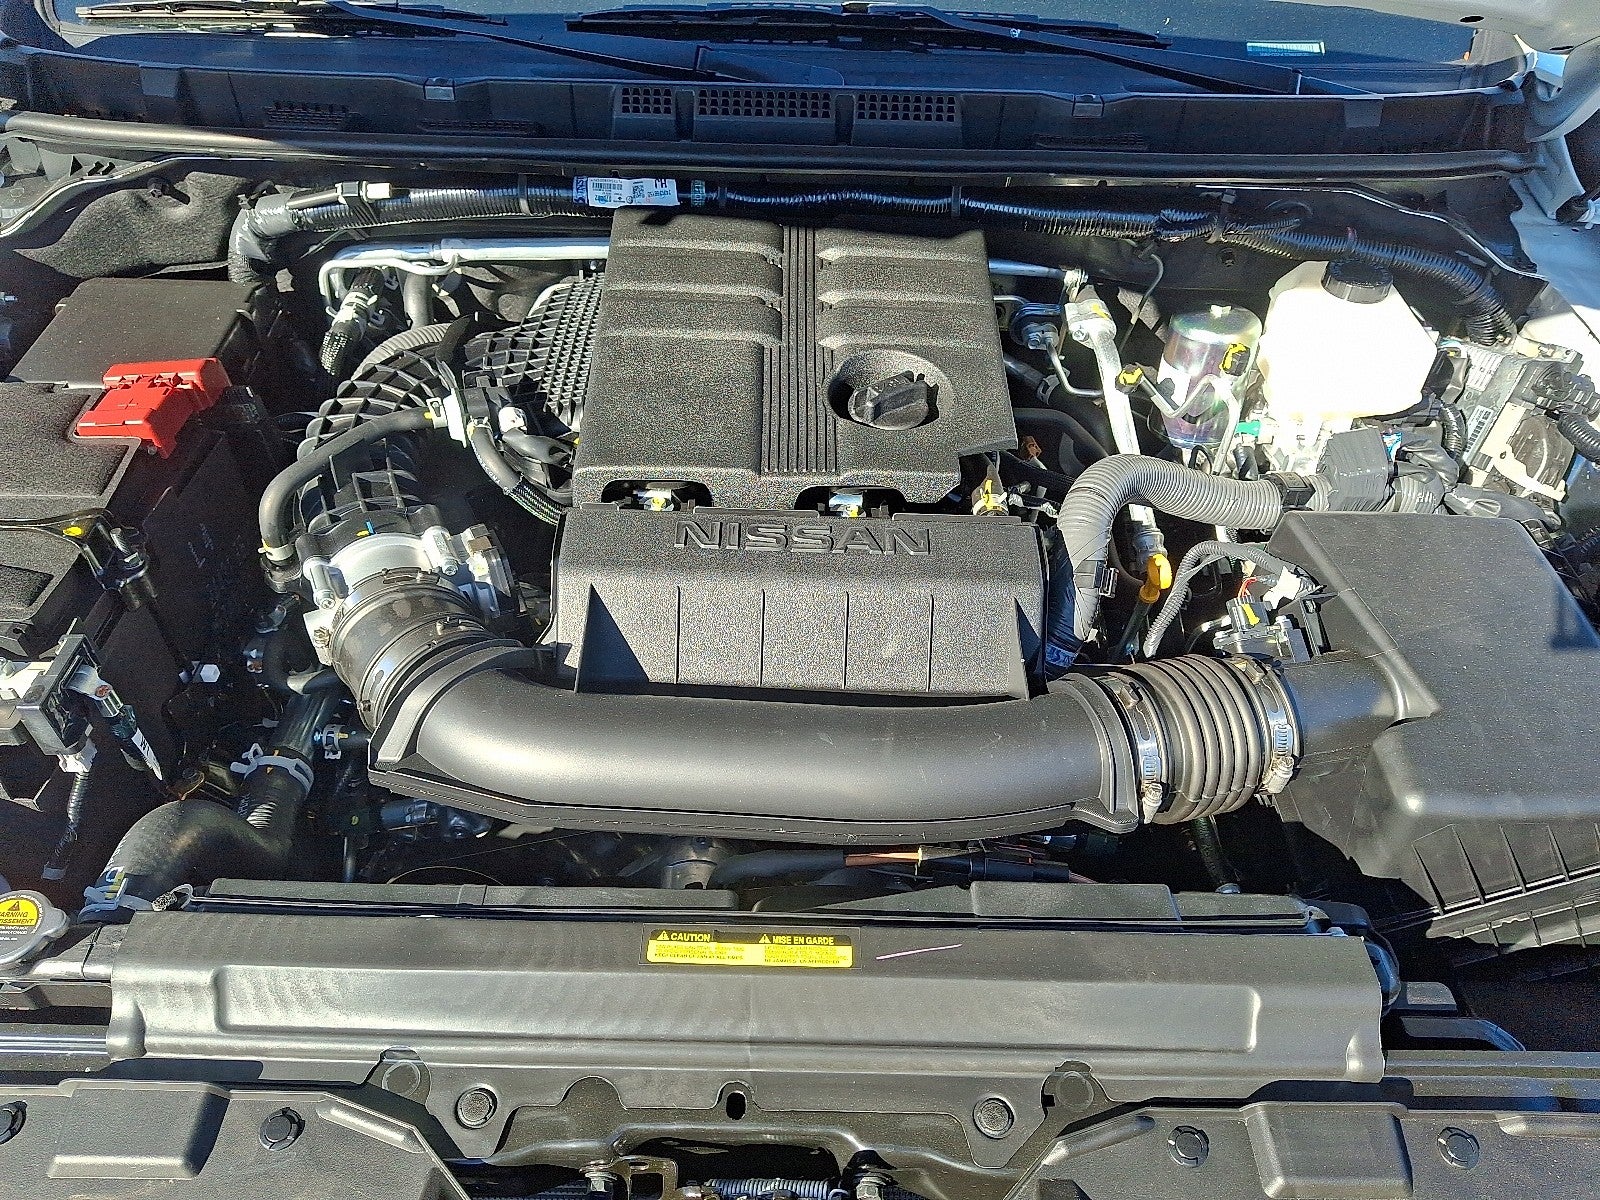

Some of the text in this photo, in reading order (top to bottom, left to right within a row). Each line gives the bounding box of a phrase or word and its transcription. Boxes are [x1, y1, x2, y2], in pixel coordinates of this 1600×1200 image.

[674, 520, 931, 556] NISSAN
[670, 932, 711, 942] CAUTION
[772, 935, 835, 945] MISE EN GARDE
